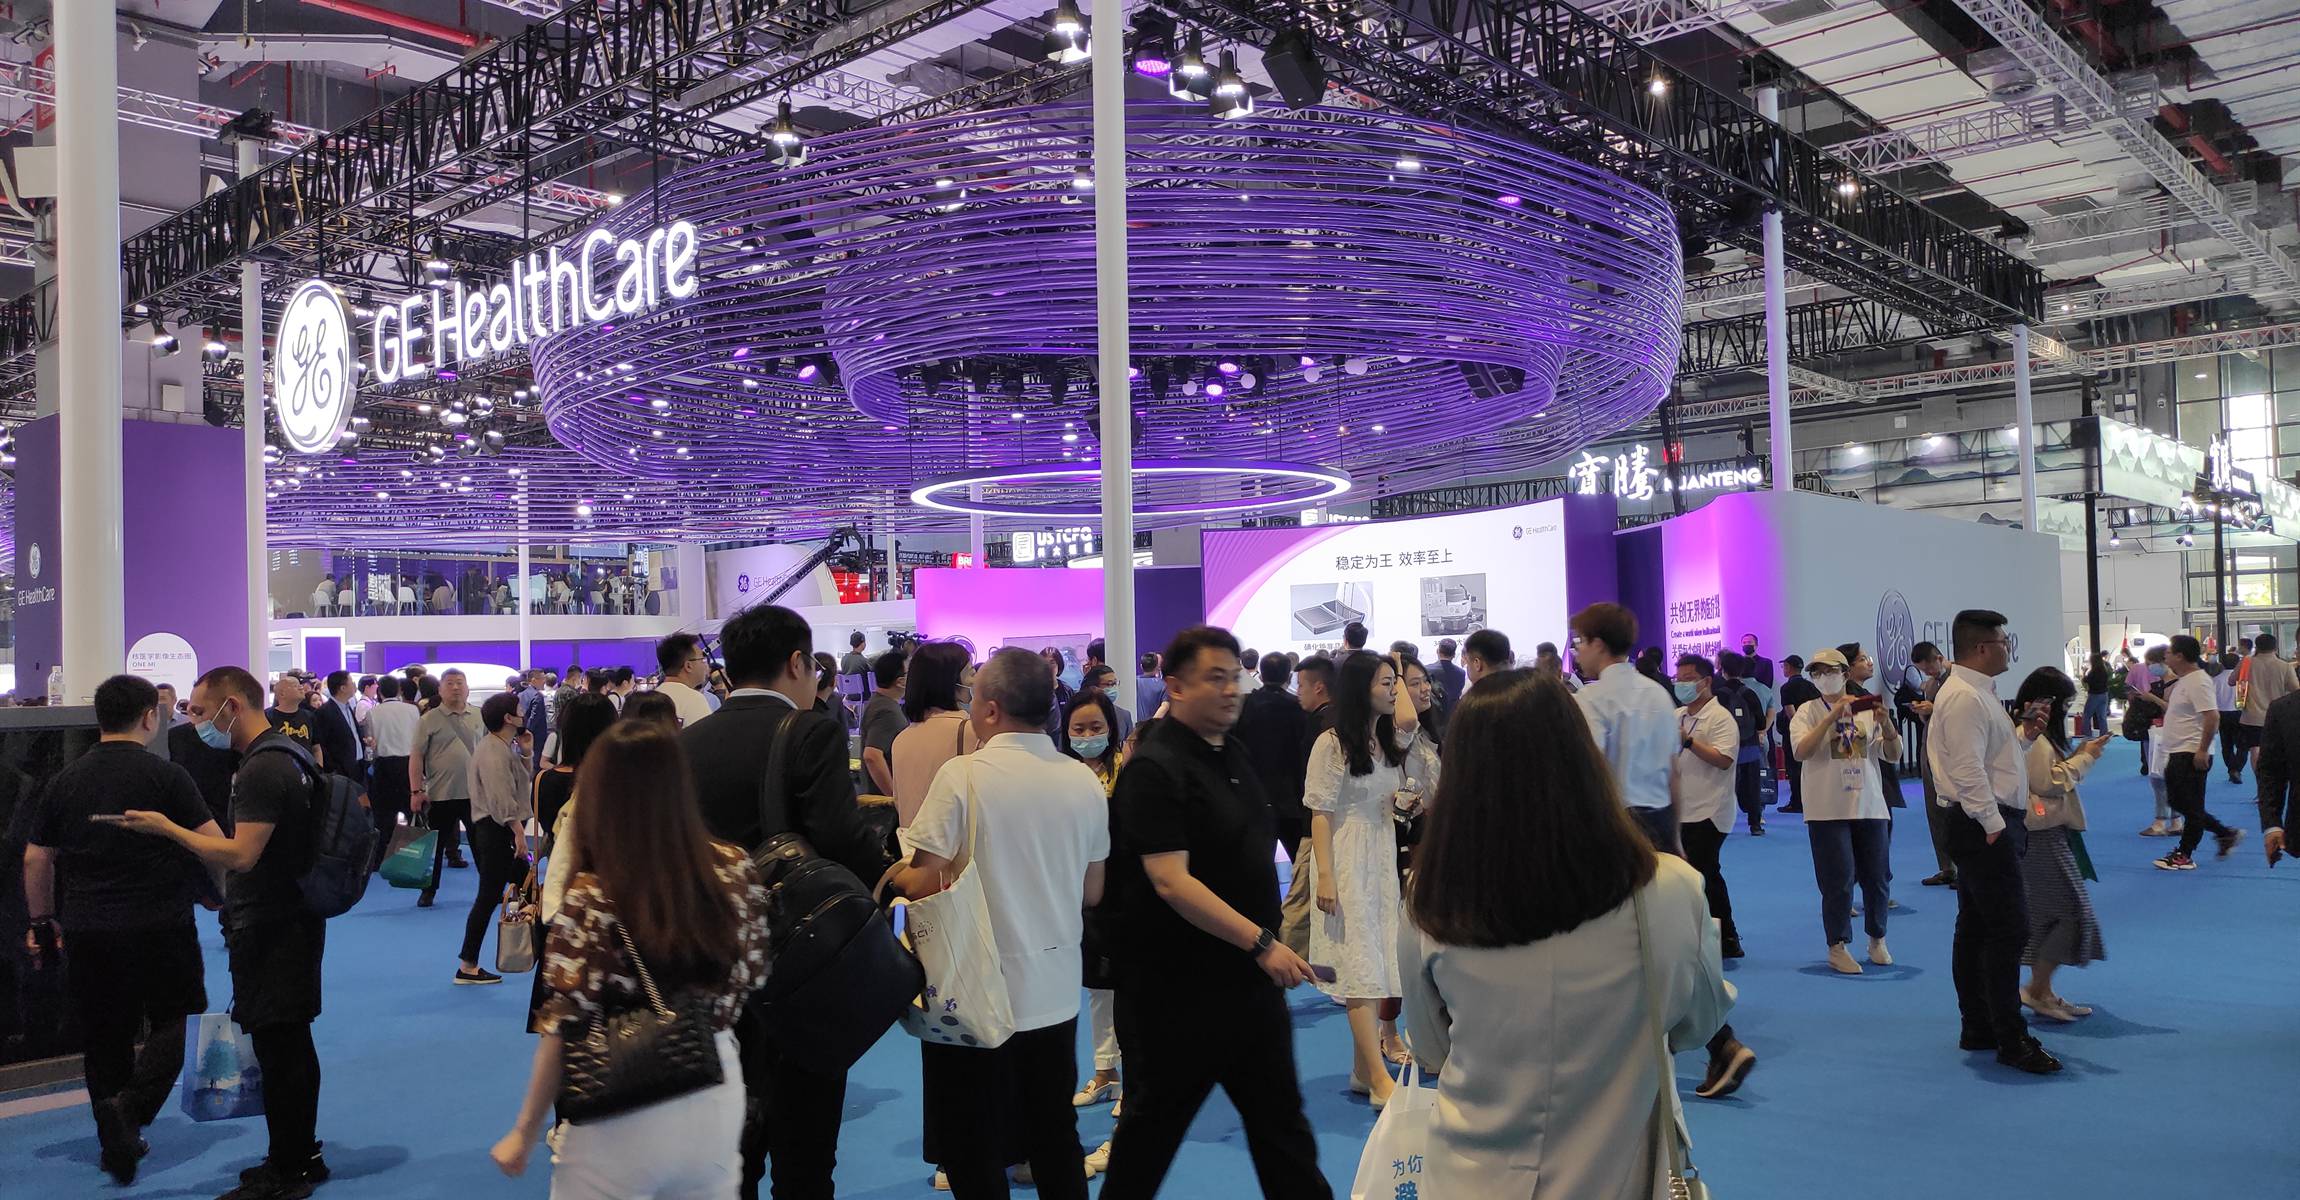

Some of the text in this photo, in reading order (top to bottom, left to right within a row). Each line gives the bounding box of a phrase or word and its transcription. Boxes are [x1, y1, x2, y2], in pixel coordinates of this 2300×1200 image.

[375, 221, 698, 384] GE HealthCare
[1335, 547, 1454, 571] 稳定为王 效率至上
[18, 586, 56, 606] GE HealthCare
[1392, 1153, 1423, 1179] 为你
